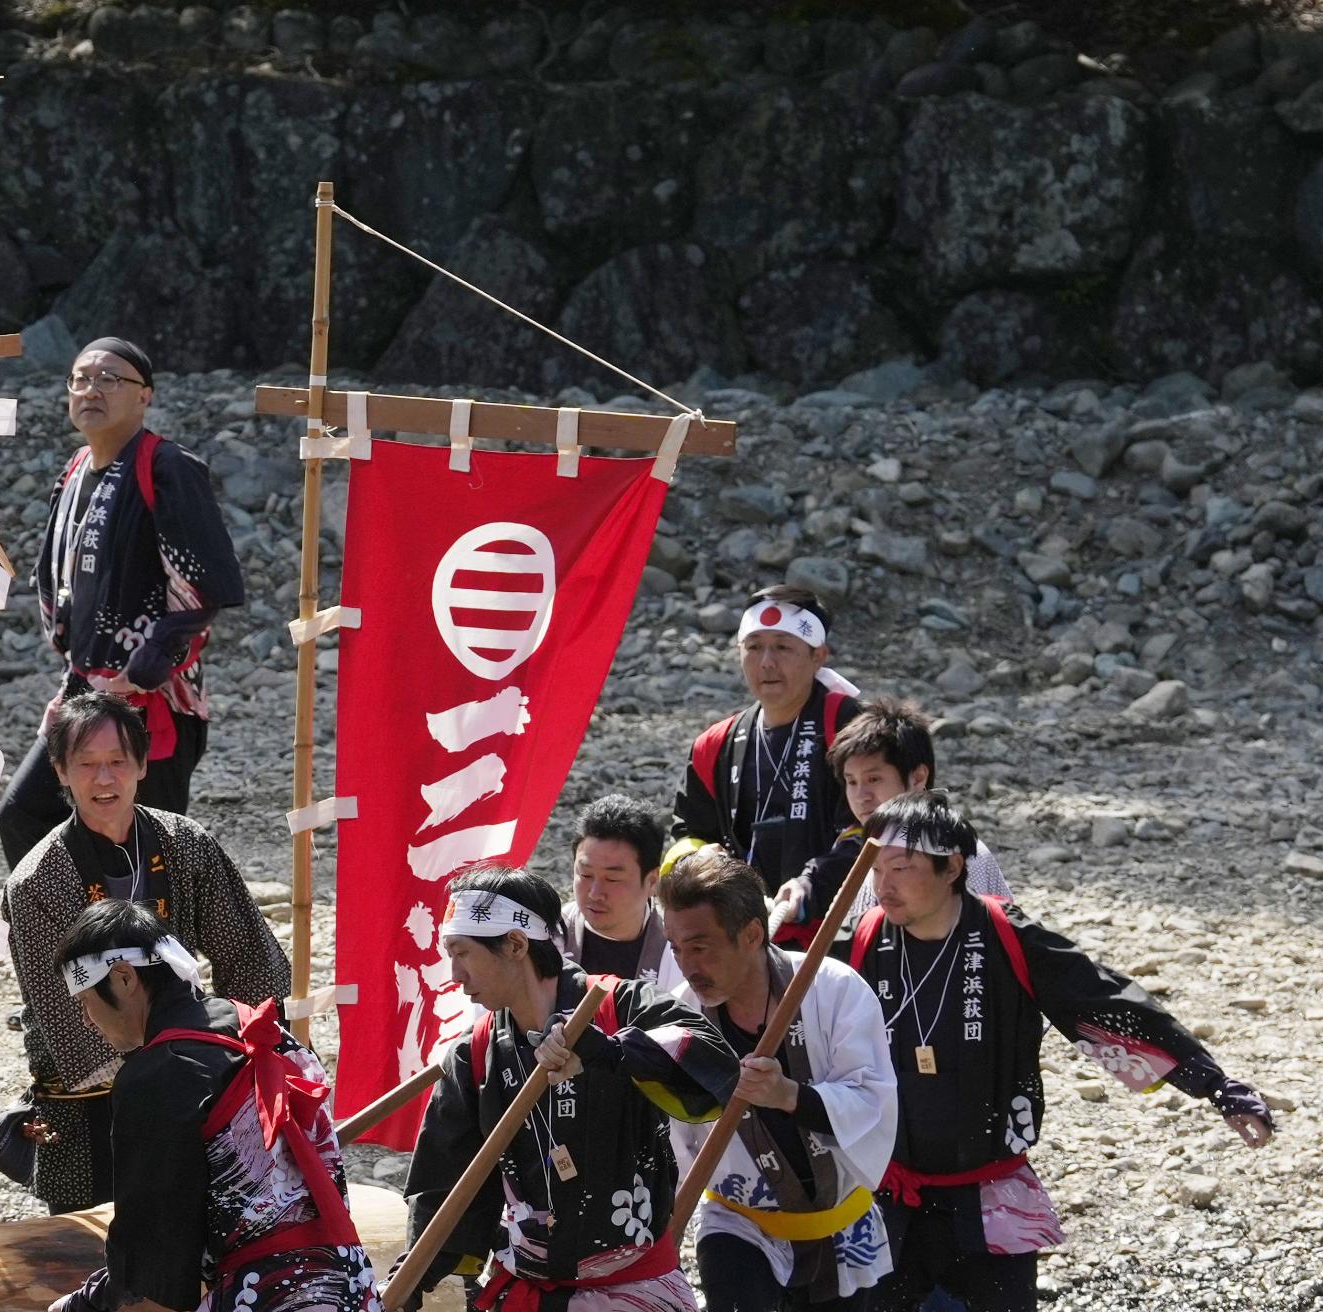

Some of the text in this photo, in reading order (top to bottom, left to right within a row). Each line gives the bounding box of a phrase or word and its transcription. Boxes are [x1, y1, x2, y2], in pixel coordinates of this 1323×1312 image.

[789, 720, 817, 821] 三津浜荻団
[962, 930, 986, 1042] 三津浜荻団
